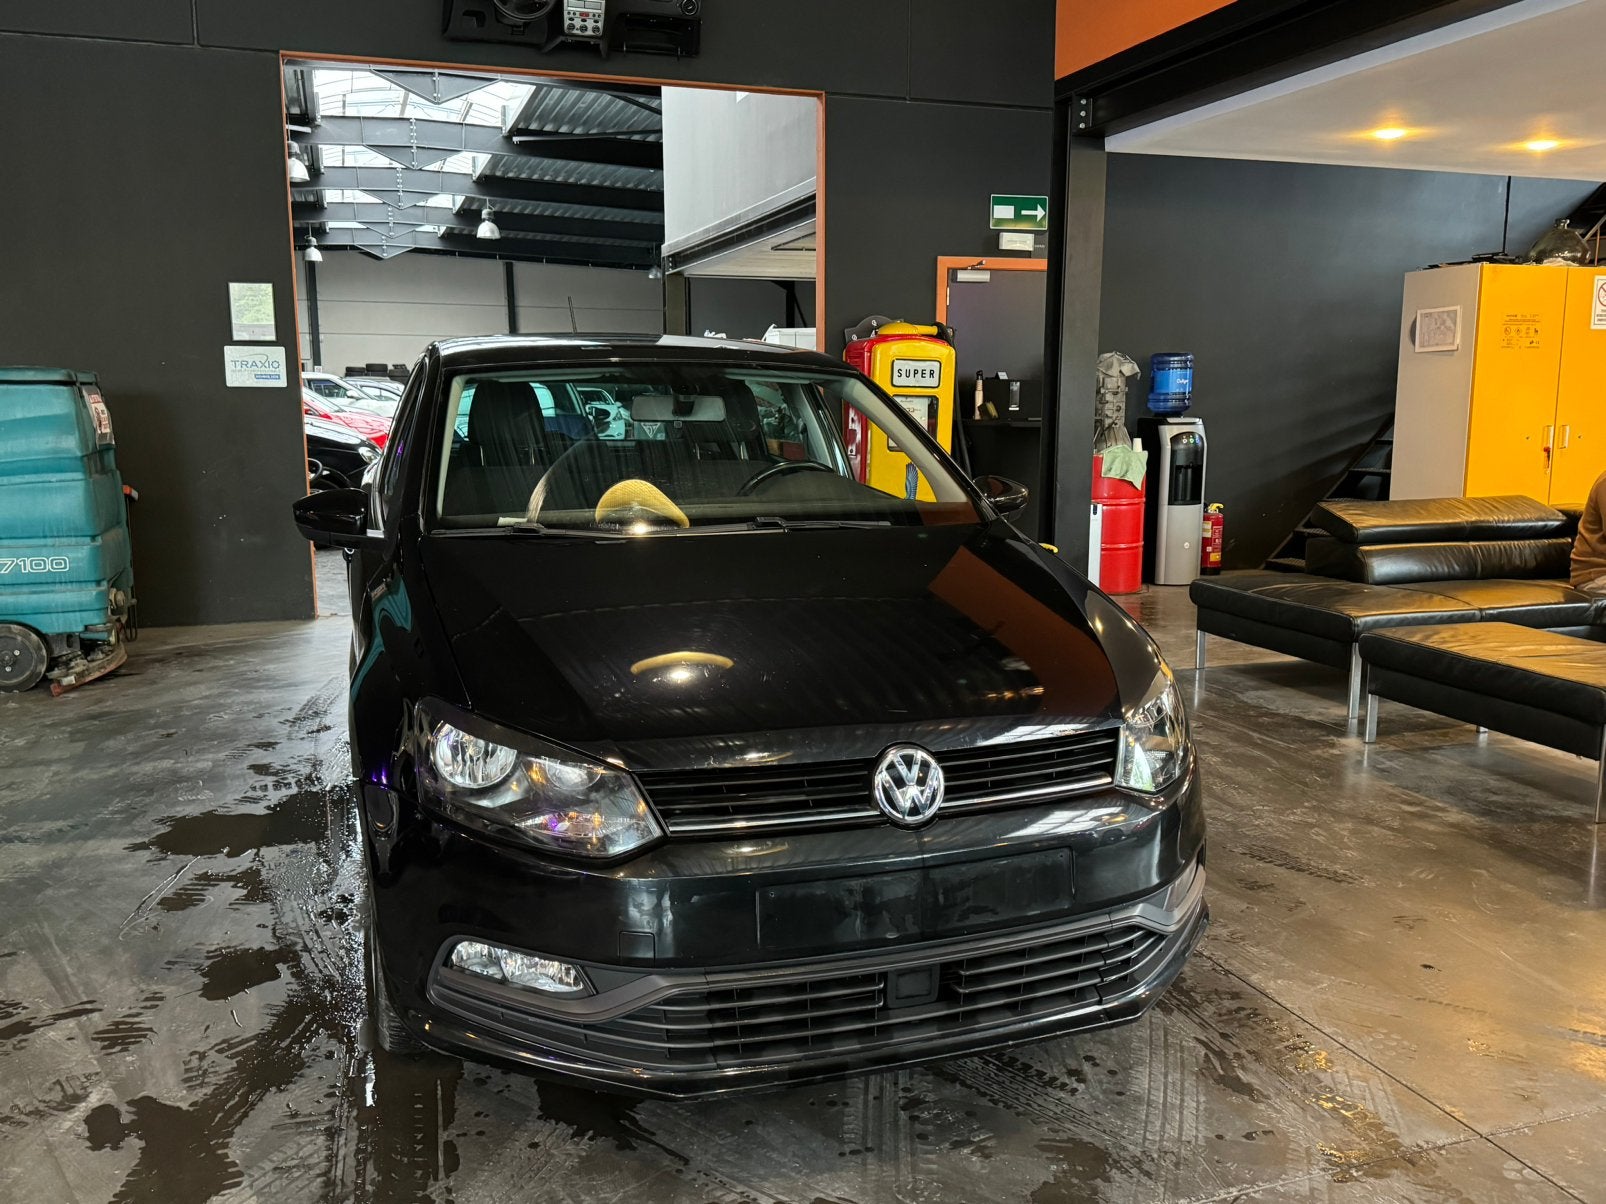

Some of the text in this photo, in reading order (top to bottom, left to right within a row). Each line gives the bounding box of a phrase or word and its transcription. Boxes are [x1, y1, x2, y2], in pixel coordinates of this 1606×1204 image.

[230, 359, 281, 370] TRAXIO
[896, 368, 936, 379] SUPER
[0, 556, 70, 573] 7100
[877, 750, 942, 820] VW
